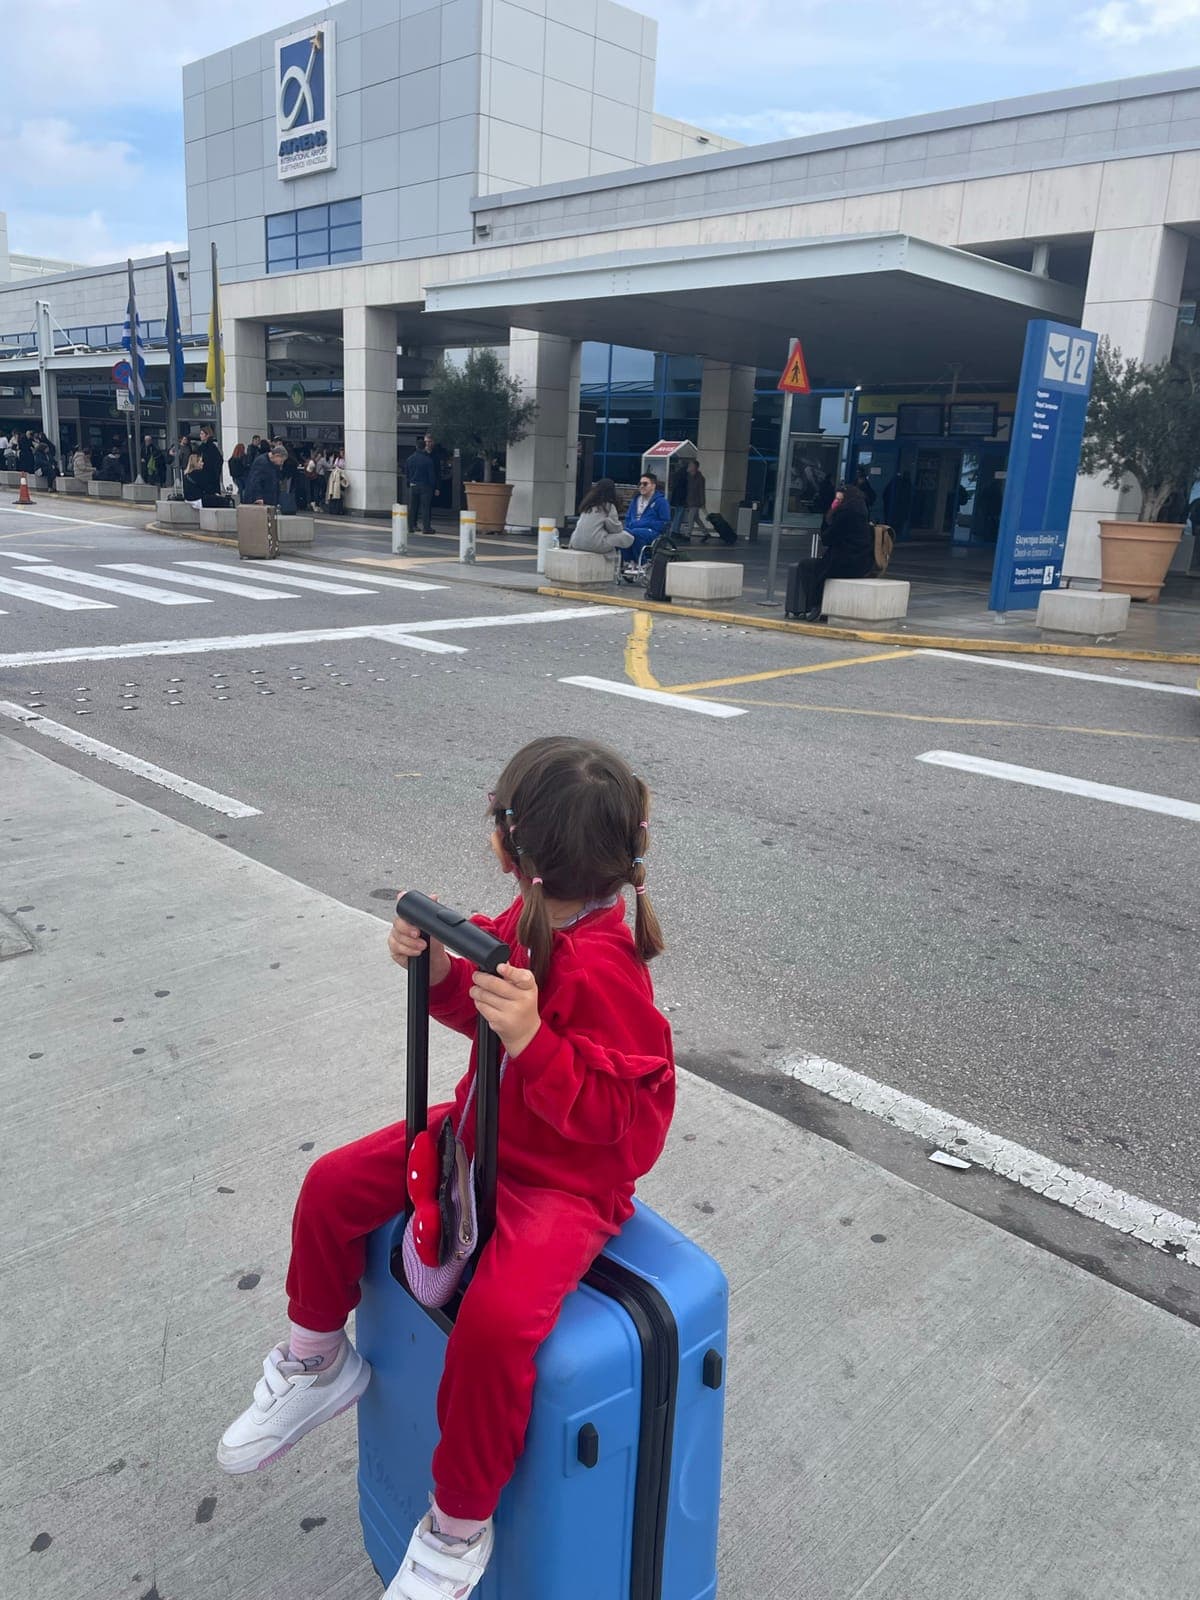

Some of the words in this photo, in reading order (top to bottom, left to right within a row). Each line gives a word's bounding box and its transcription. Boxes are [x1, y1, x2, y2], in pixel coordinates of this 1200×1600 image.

[279, 130, 327, 157] ATHENS
[1073, 345, 1085, 379] 2
[286, 410, 307, 419] VENETI
[402, 404, 428, 414] VENETI
[862, 420, 869, 436] 2
